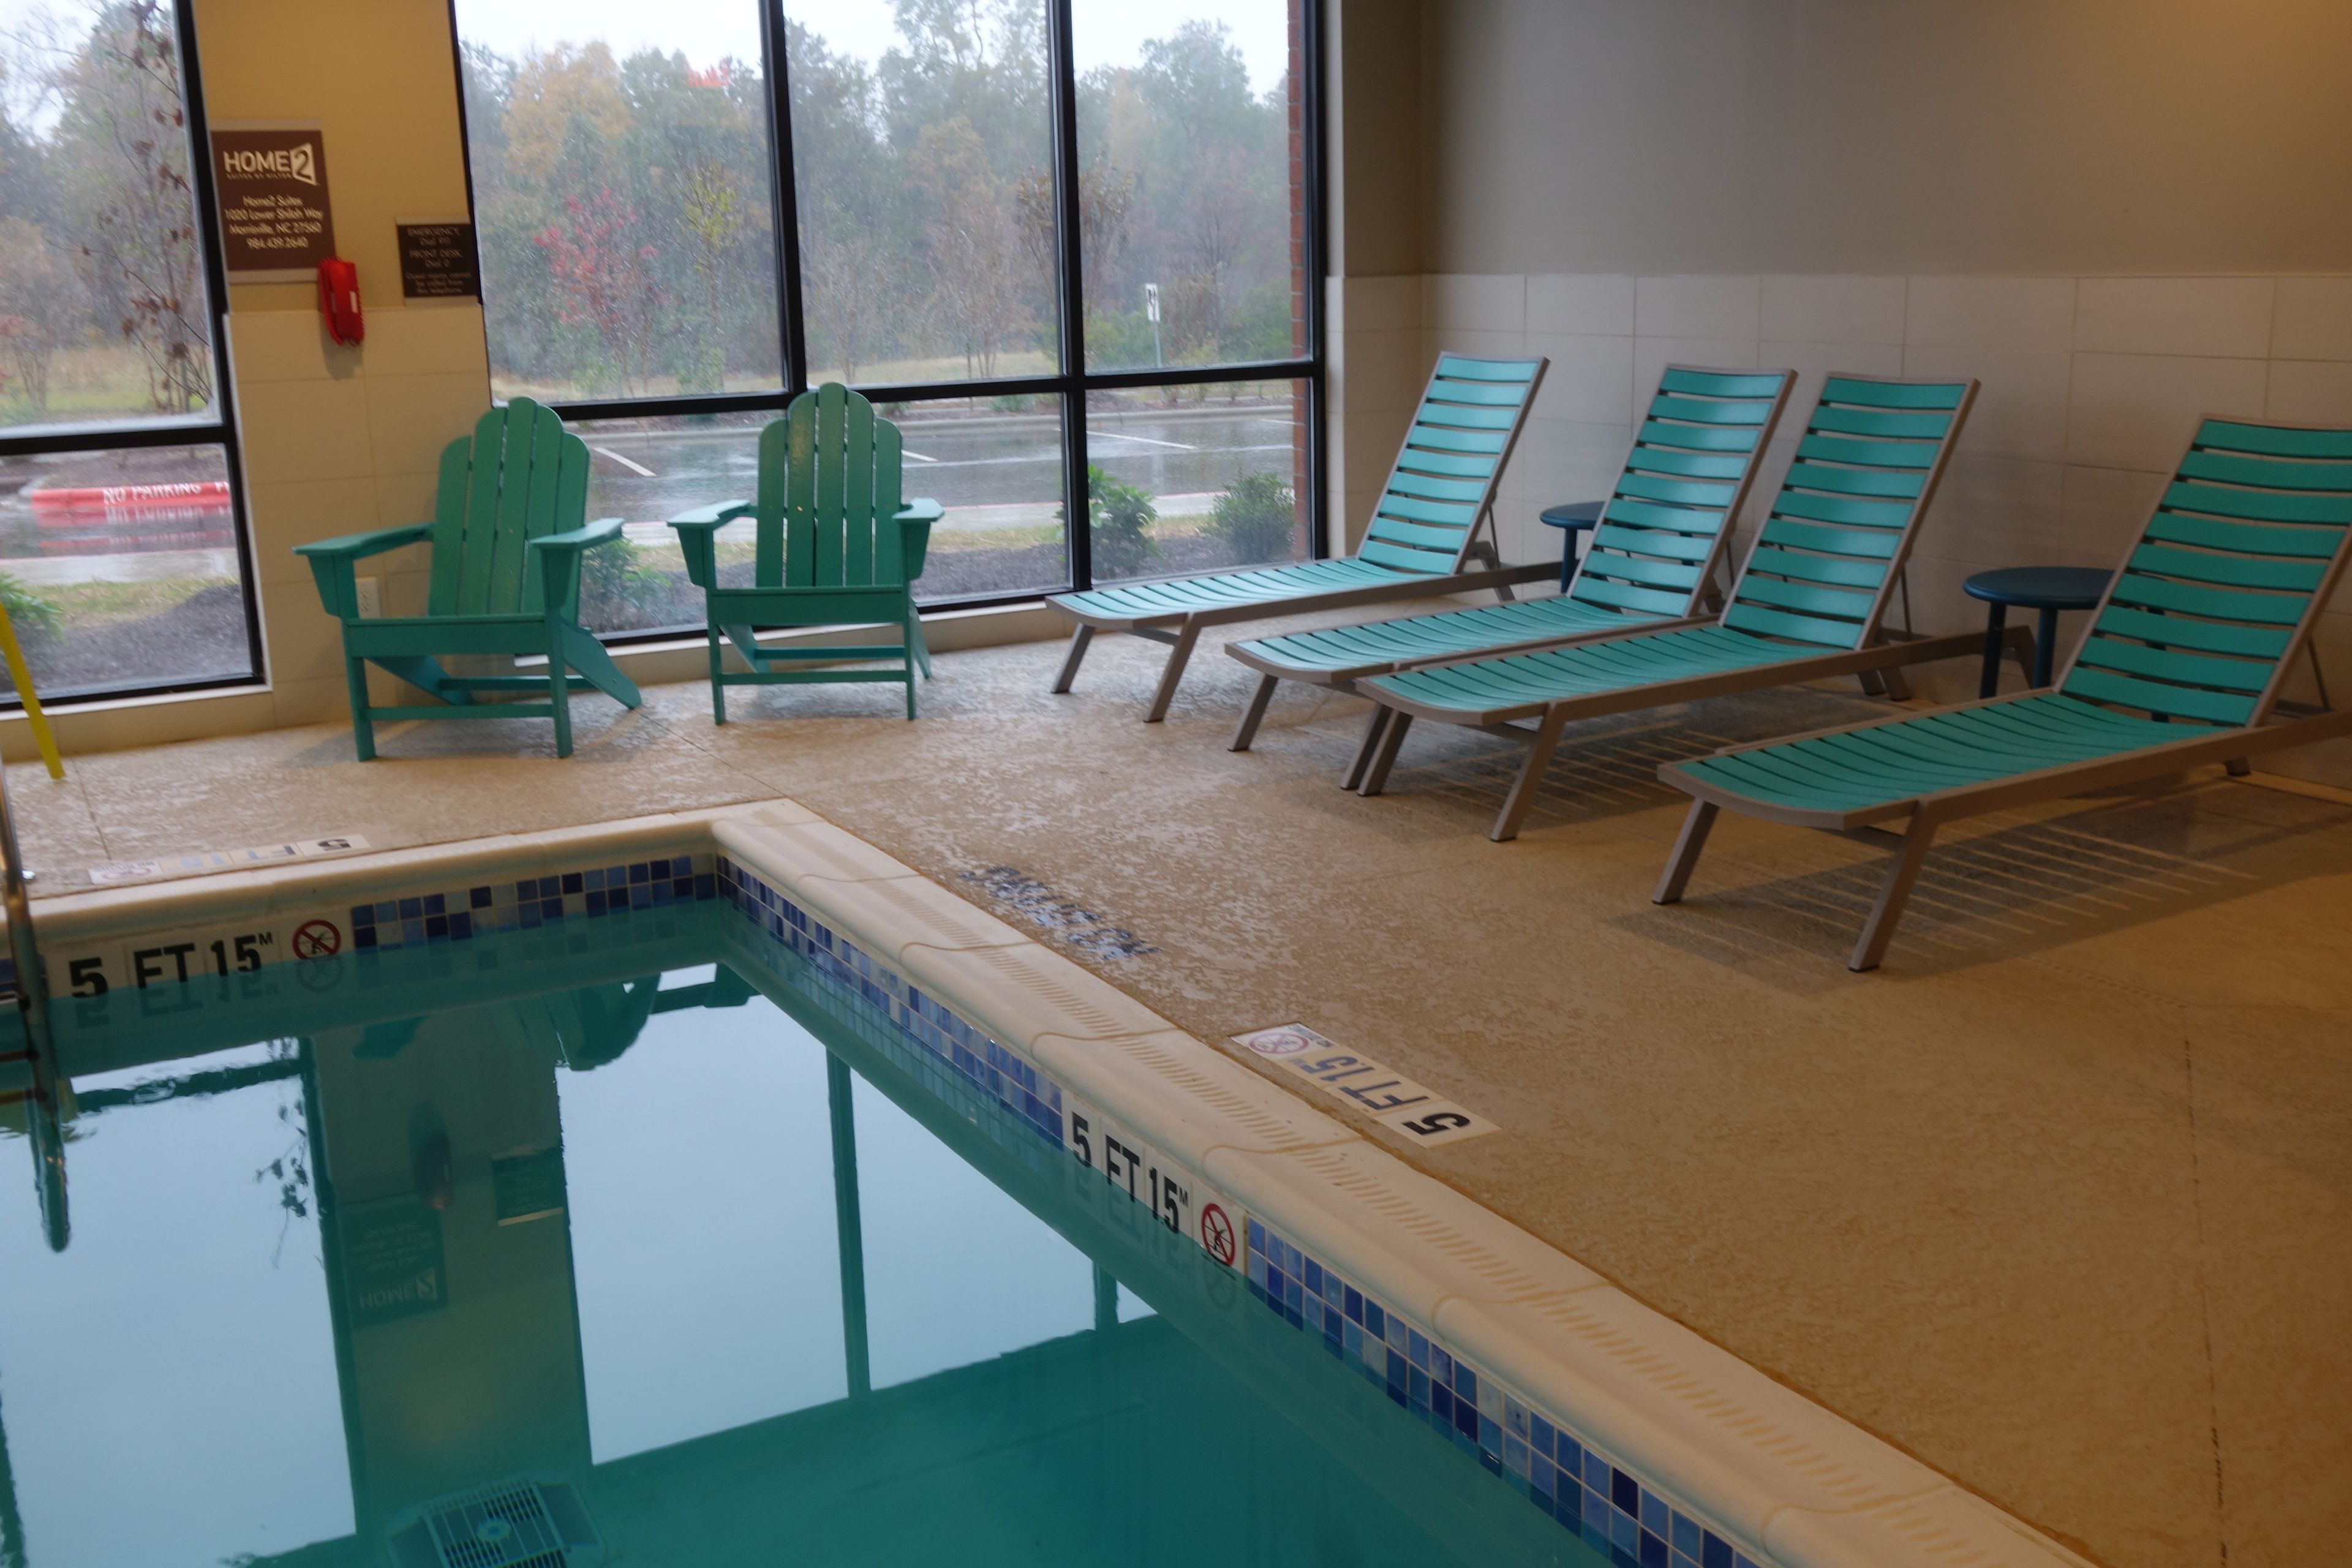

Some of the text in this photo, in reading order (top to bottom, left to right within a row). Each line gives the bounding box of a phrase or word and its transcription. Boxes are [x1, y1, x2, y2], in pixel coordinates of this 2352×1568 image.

[103, 486, 127, 505] NO
[130, 483, 203, 502] PARKING
[69, 957, 109, 998] 5
[133, 943, 195, 989] FT
[1338, 1080, 1431, 1111] FT
[1401, 1112, 1471, 1136] 5
[1071, 1110, 1091, 1167] 5
[1105, 1133, 1140, 1204] FT
